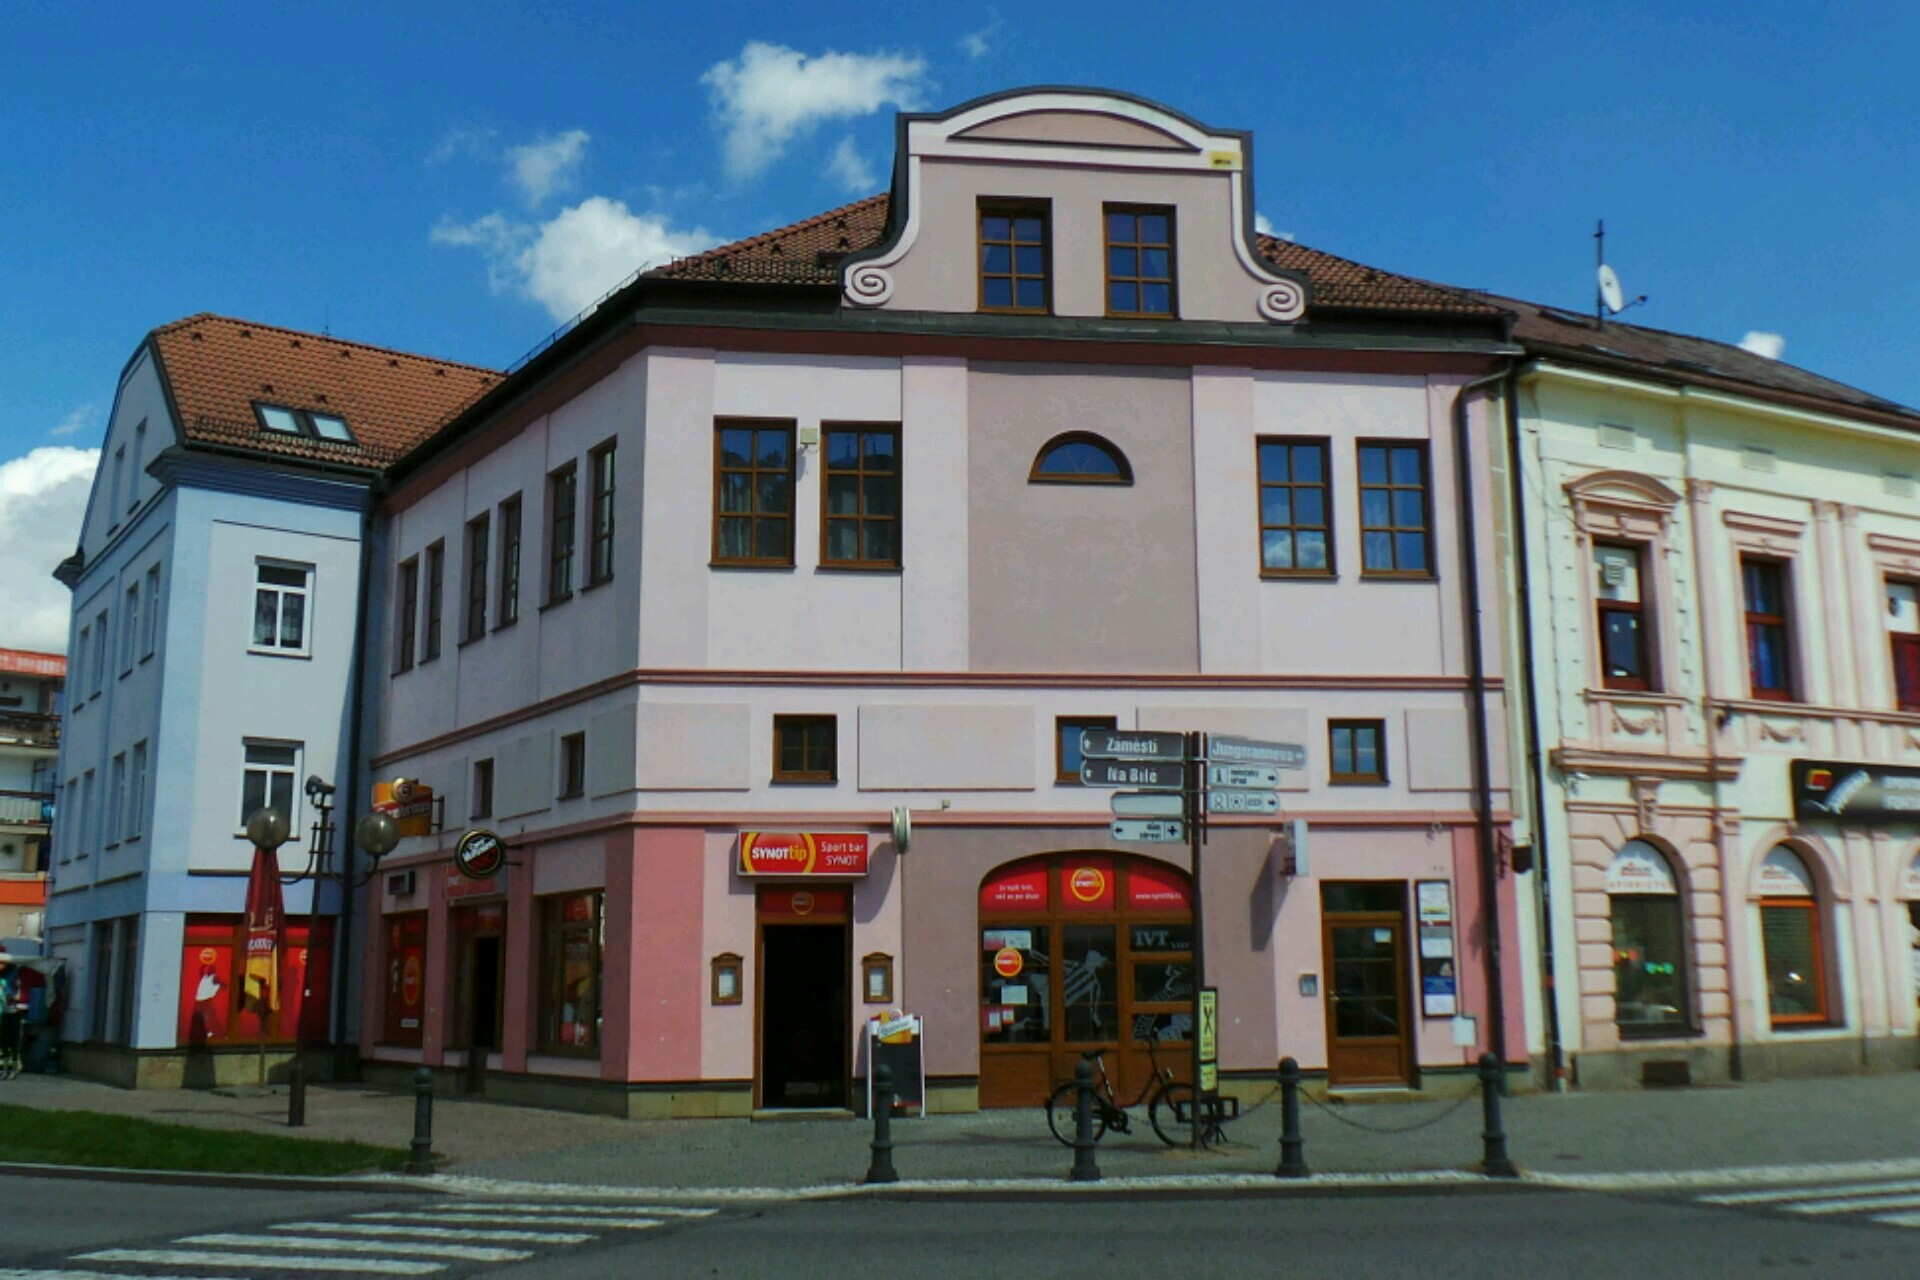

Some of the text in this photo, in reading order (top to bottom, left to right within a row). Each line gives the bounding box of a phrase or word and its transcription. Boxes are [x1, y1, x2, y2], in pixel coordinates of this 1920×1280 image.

[1107, 766, 1127, 782] Na
[821, 841, 864, 853] Sport bar
[825, 855, 859, 865] SYNOT
